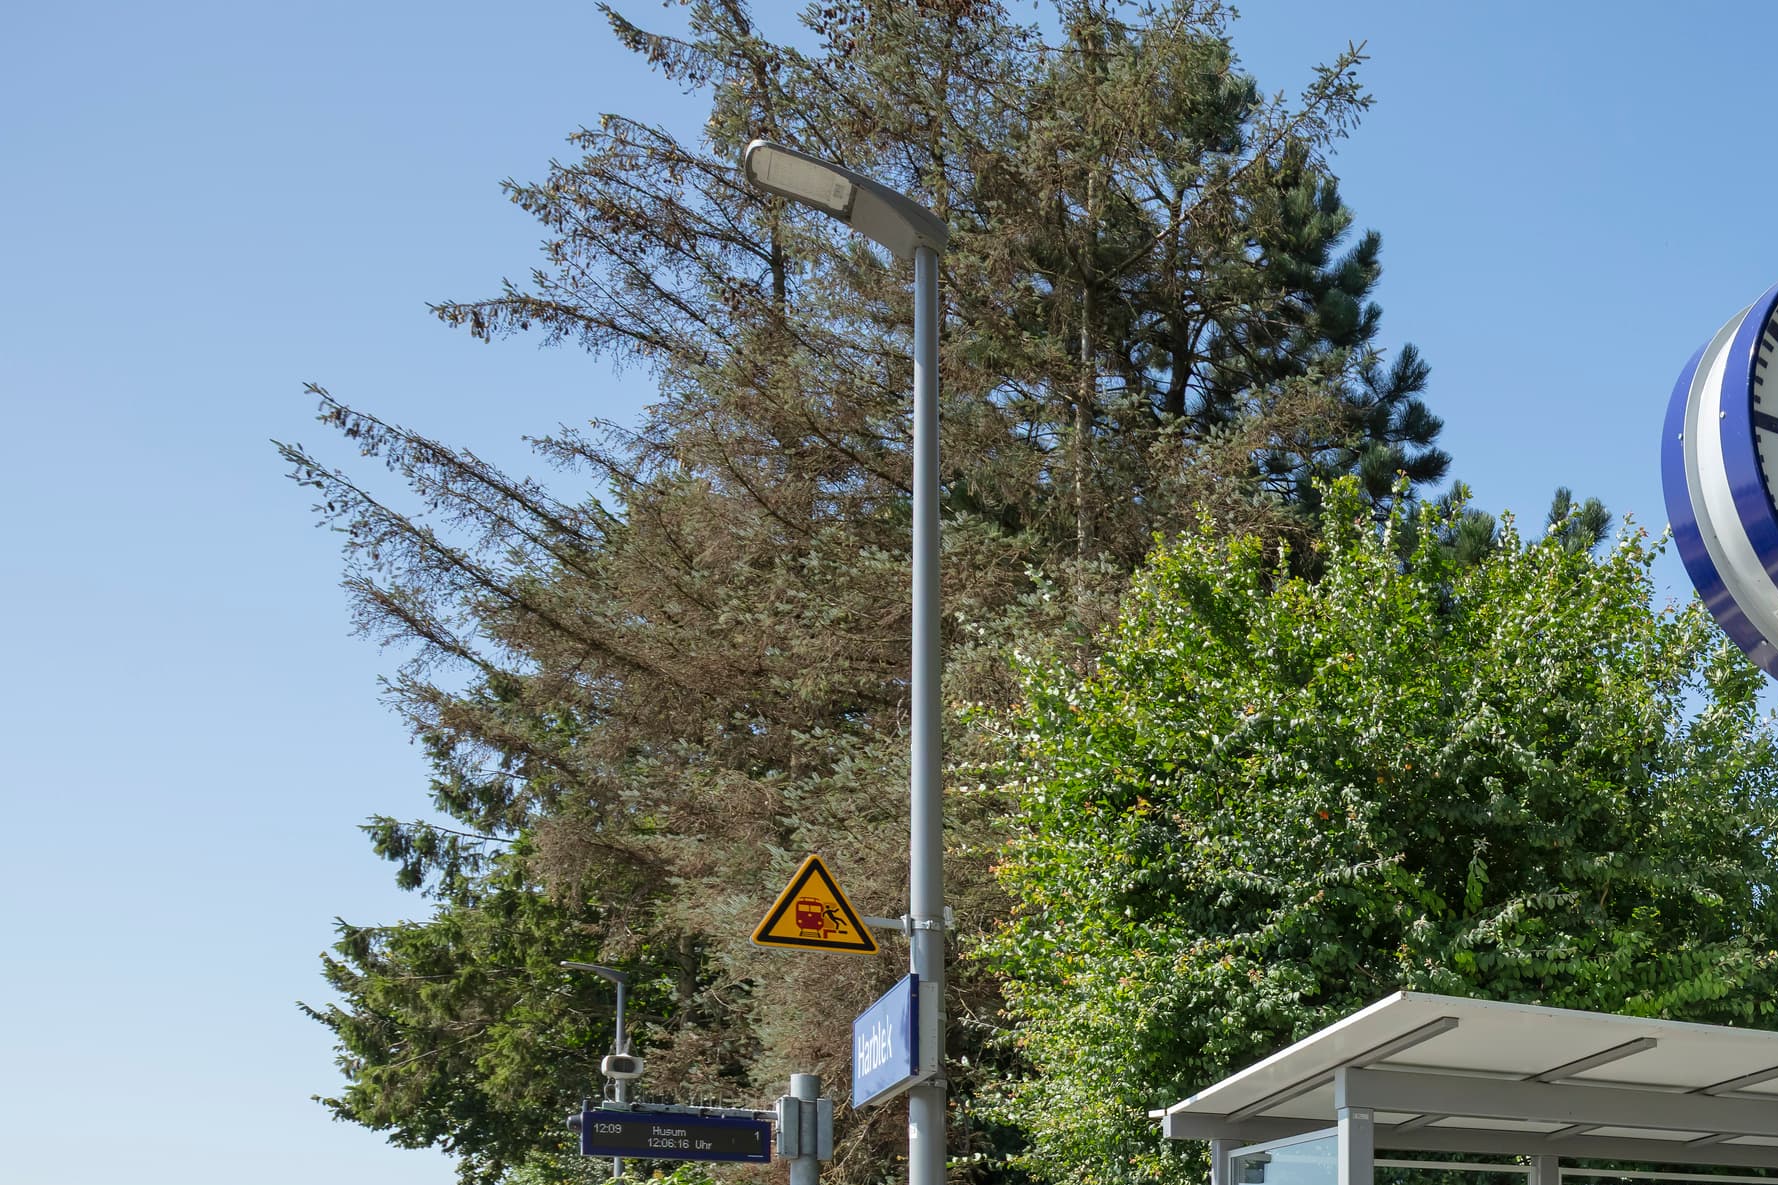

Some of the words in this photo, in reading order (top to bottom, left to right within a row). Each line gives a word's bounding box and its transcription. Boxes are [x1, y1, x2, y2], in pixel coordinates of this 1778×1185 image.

[857, 1015, 892, 1079] Harblek
[653, 1126, 687, 1137] Husum
[648, 1138, 689, 1149] 12:06:16
[695, 1140, 713, 1150] Uhr
